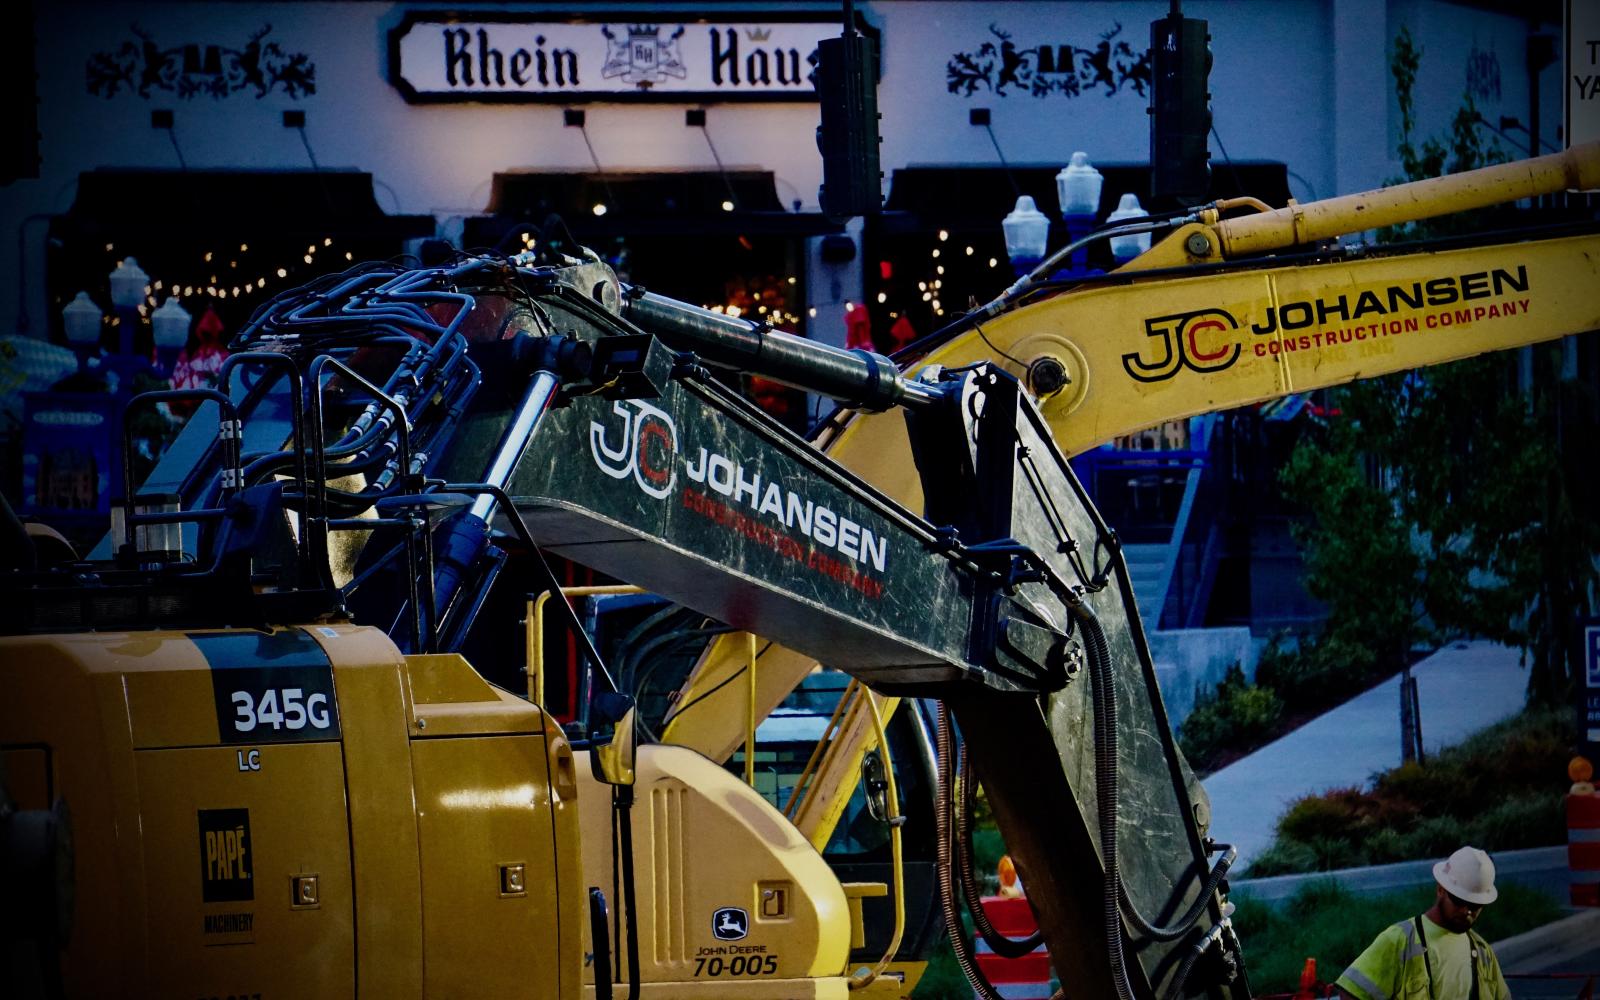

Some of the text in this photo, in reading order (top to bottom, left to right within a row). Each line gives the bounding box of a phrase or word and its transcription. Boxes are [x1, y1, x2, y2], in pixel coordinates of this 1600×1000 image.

[443, 26, 580, 88] Rhein
[1252, 265, 1529, 335] JOHANSEN
[1122, 307, 1242, 383] JC
[1254, 318, 1419, 357] CONSTRUCTION
[1426, 299, 1531, 329] COMPANY
[687, 447, 887, 573] JOHANSEN
[231, 688, 330, 732] 345G
[238, 749, 261, 771] LC
[204, 912, 254, 934] MACHINERY
[694, 955, 778, 977] 70-005
[696, 945, 767, 956] JOHN DEERE
